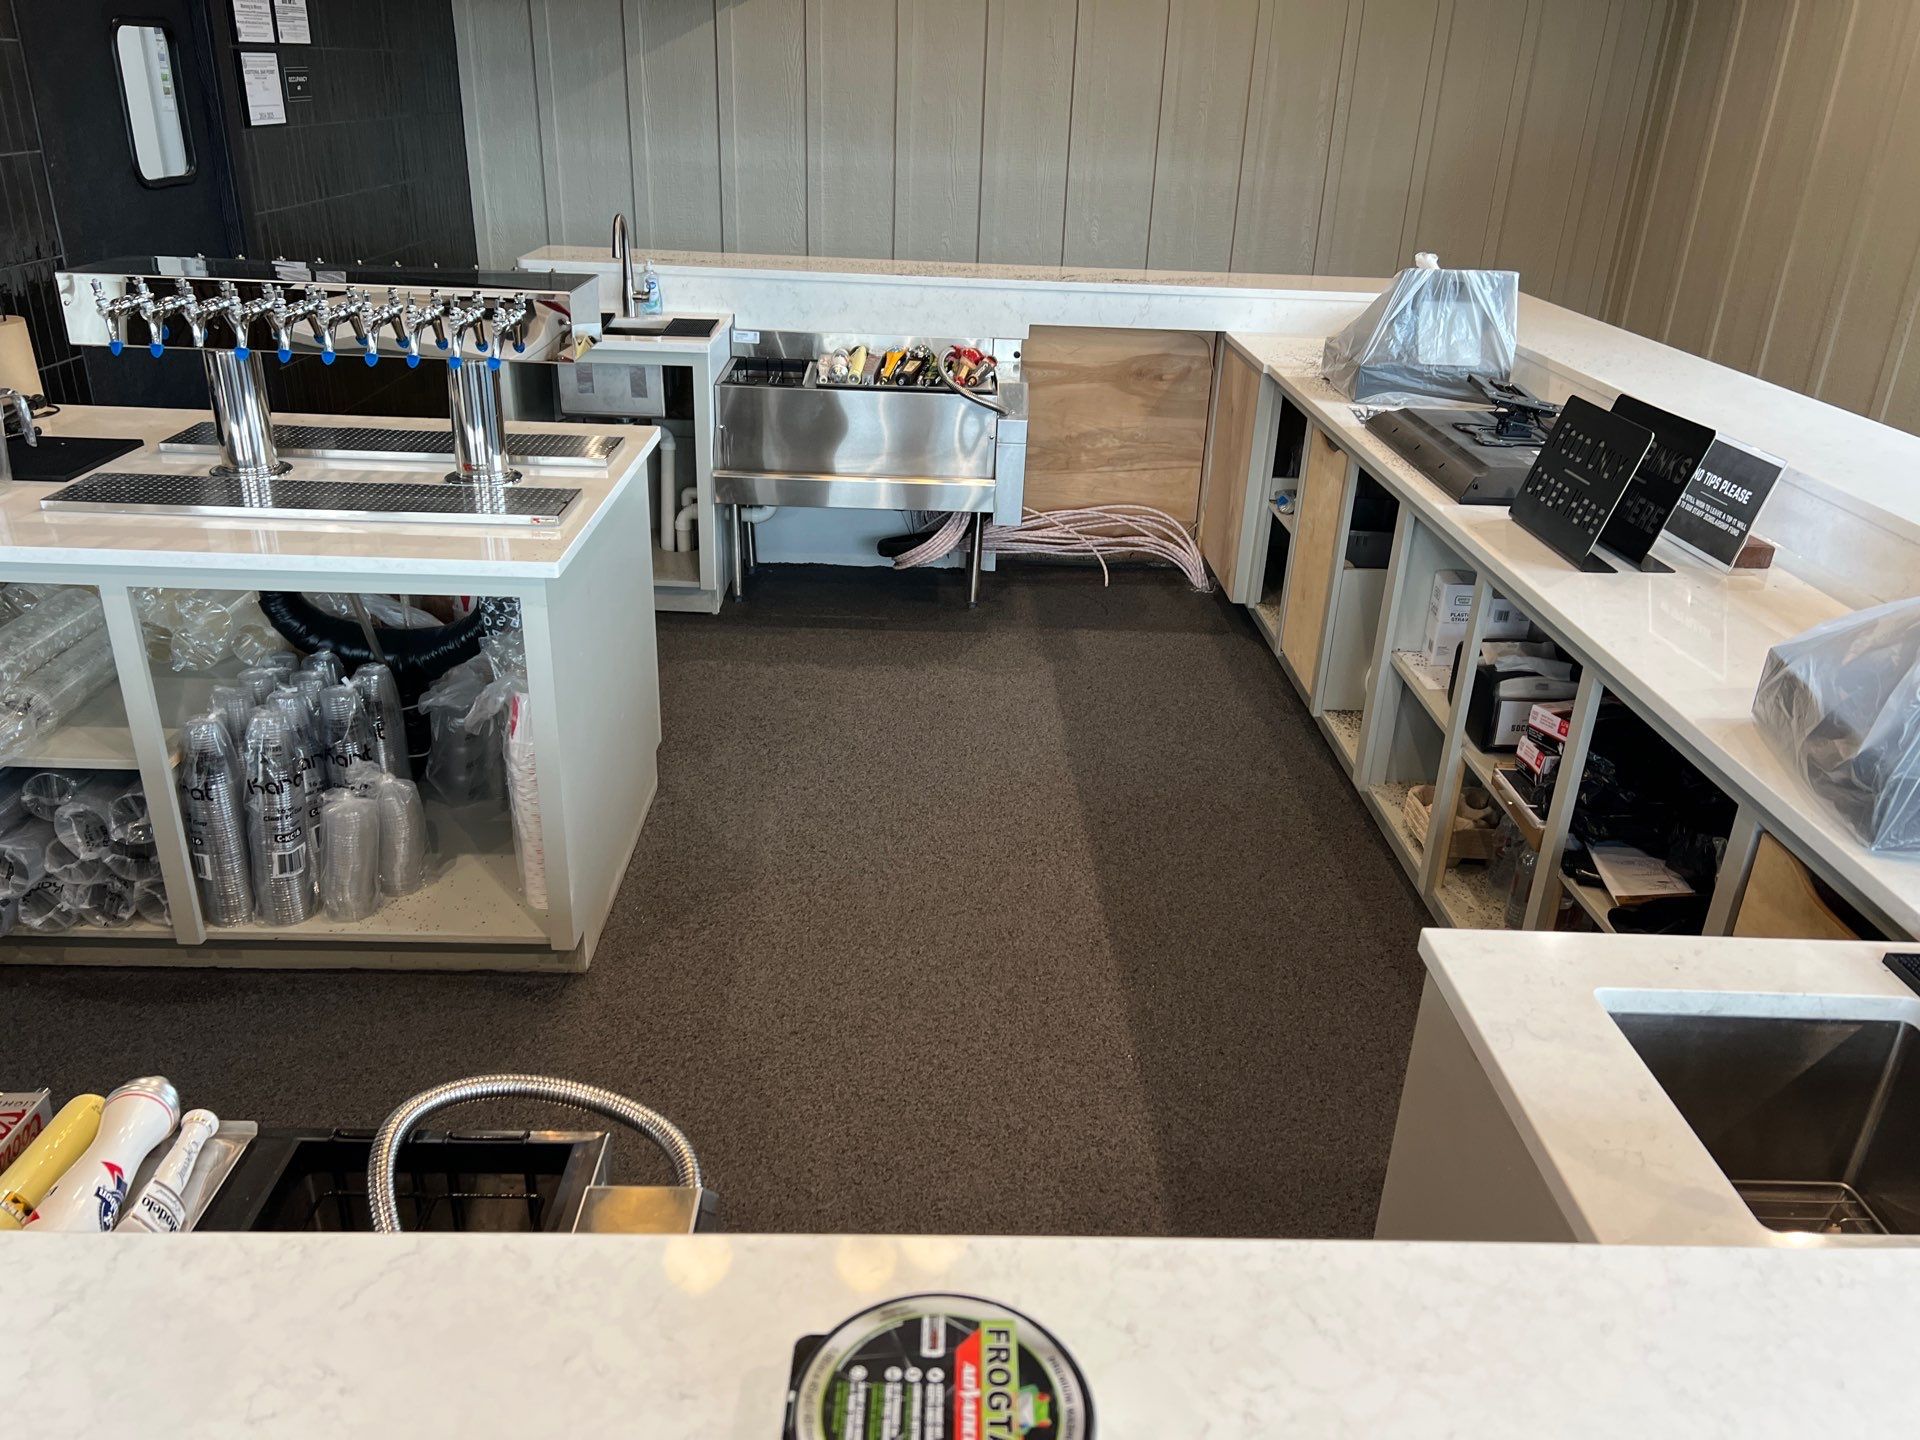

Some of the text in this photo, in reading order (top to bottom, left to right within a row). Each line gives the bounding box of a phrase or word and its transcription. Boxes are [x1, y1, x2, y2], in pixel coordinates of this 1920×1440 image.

[1643, 441, 1693, 484] RINKS
[1694, 468, 1753, 505] NO TIPS PLEASE
[1709, 506, 1723, 518] LEAVE
